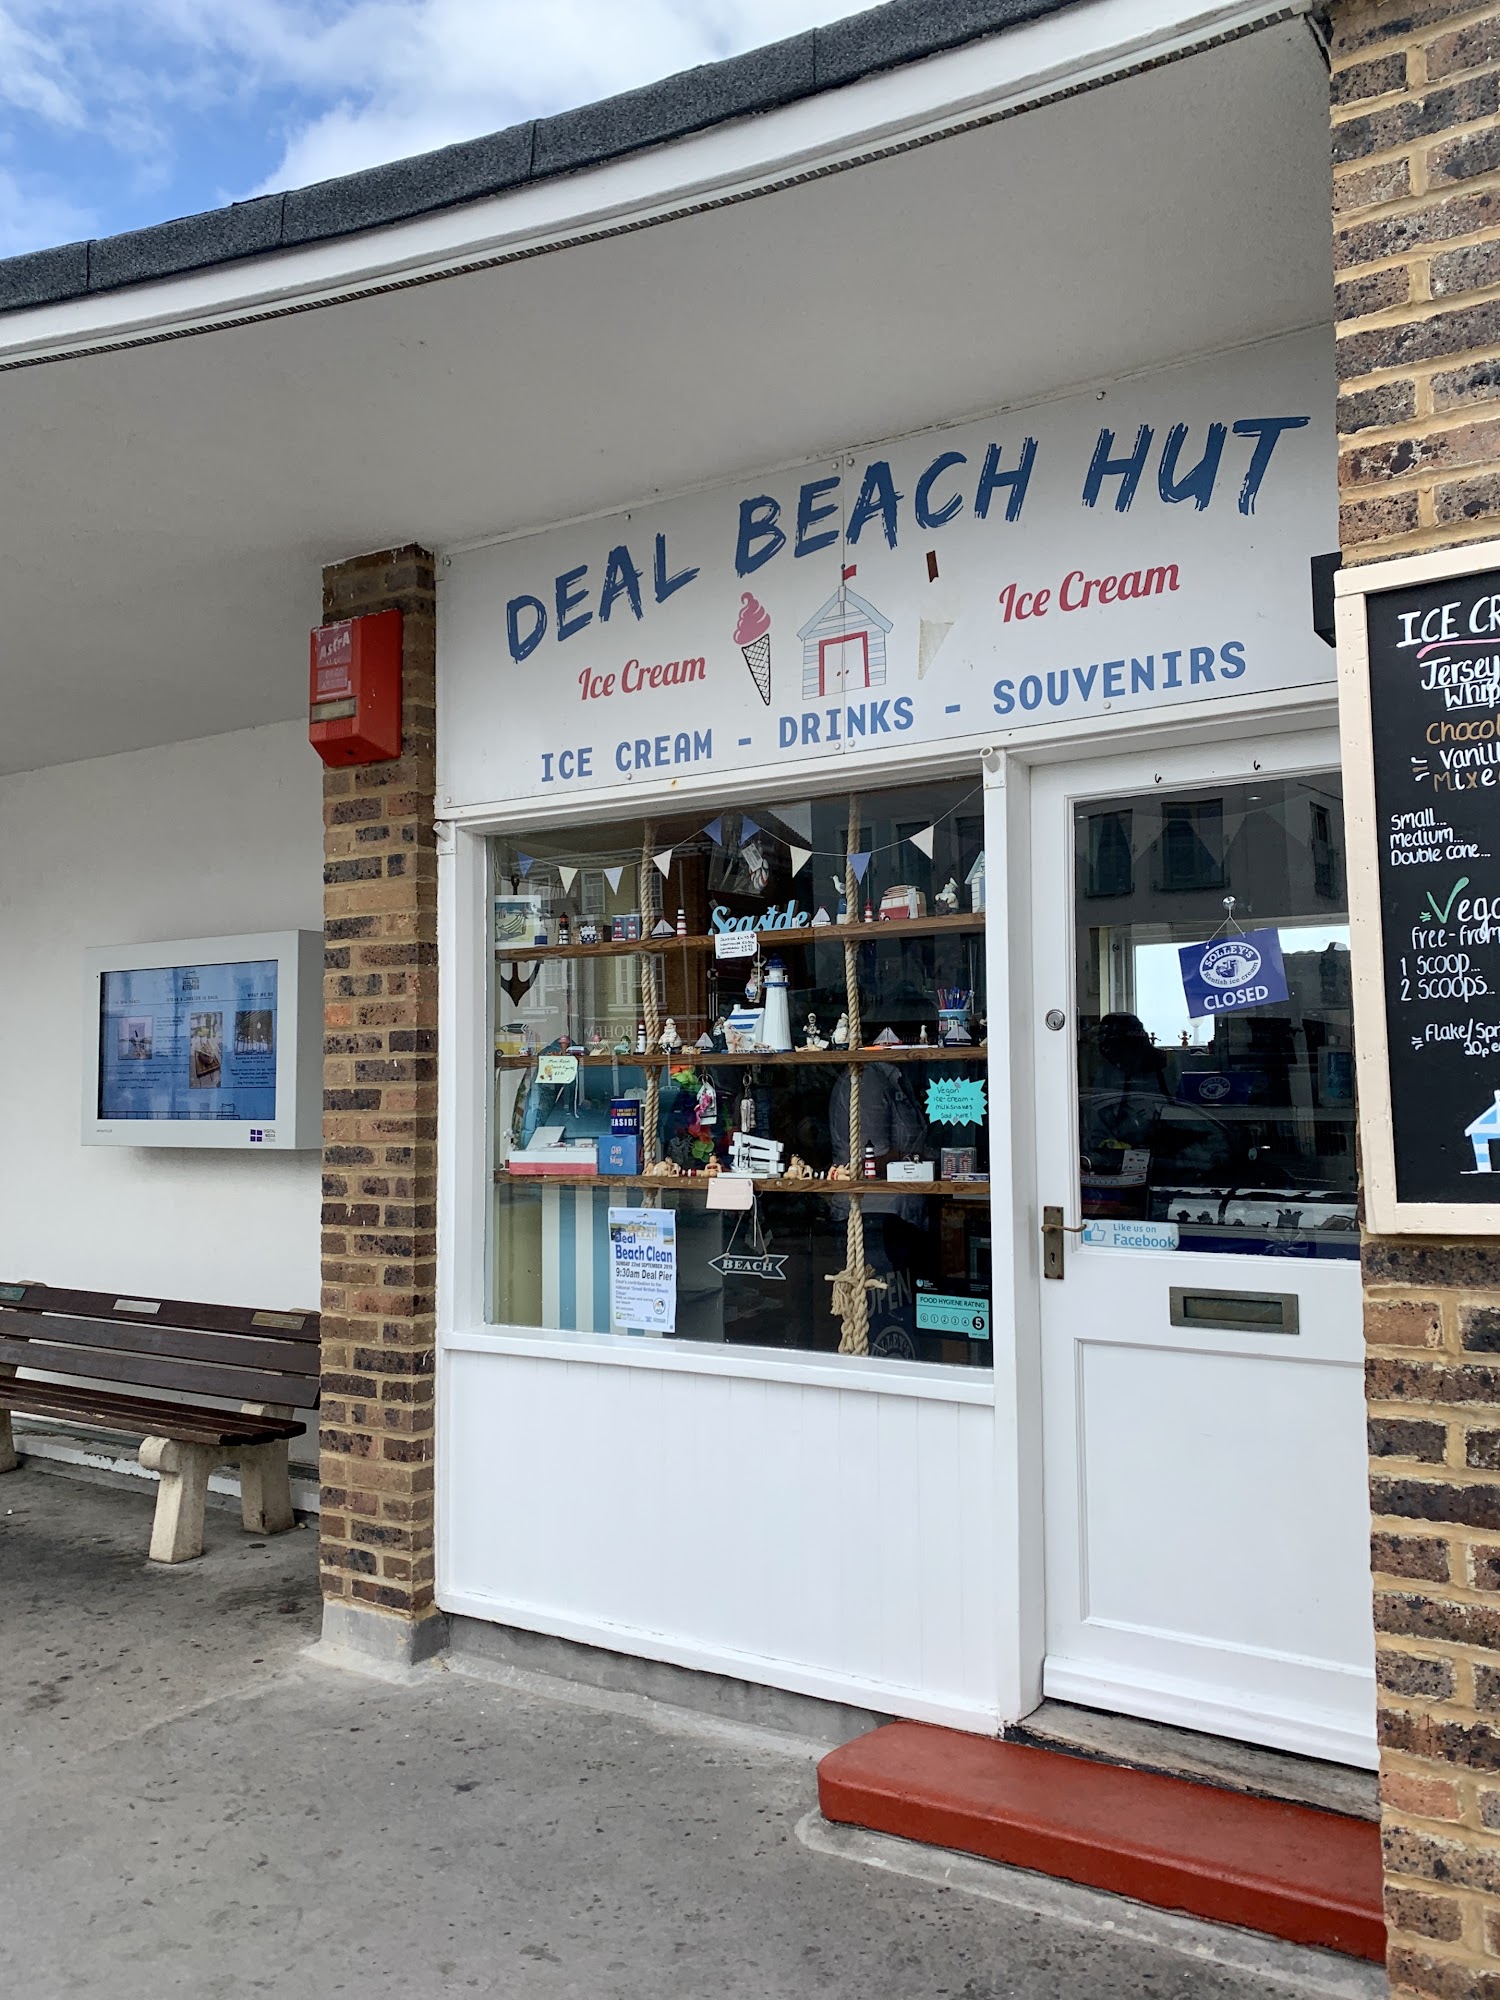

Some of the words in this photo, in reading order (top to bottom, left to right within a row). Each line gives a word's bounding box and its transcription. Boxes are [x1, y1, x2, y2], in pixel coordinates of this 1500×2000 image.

[505, 536, 700, 662] DEAL
[735, 437, 1038, 577] BEACH
[1082, 416, 1309, 516] HUT
[999, 583, 1051, 624] Ice
[1059, 563, 1180, 613] Cream
[1396, 601, 1461, 648] ICE
[578, 668, 616, 701] Ice
[621, 656, 706, 693] Cream
[1420, 655, 1500, 690] Jersey
[541, 747, 593, 783] ICE
[615, 729, 712, 772] CREAM
[779, 695, 915, 748] DRINKS
[992, 640, 1247, 715] SOUVENIRS
[1433, 767, 1500, 792] Mixe
[708, 899, 810, 936] Seaside
[1204, 945, 1254, 968] SOLLEY'S
[1400, 957, 1407, 976] 1
[1229, 976, 1240, 985] ice
[1401, 978, 1412, 1001] 2
[1203, 985, 1269, 1011] CLOSED
[1463, 1041, 1490, 1057] 20p
[937, 1086, 960, 1096] Vegan
[1113, 1223, 1132, 1232] Like
[1113, 1233, 1176, 1248] Facebook
[615, 1244, 645, 1261] Beach
[646, 1245, 673, 1263] Clean
[615, 1267, 640, 1278] 9:30am
[641, 1269, 657, 1280] Deal
[658, 1271, 673, 1281] Pier
[722, 1259, 773, 1272] BEACH
[920, 1296, 937, 1304] FOOD
[938, 1298, 963, 1307] HYGIENE
[963, 1300, 985, 1308] RATING
[974, 1317, 982, 1329] 5
